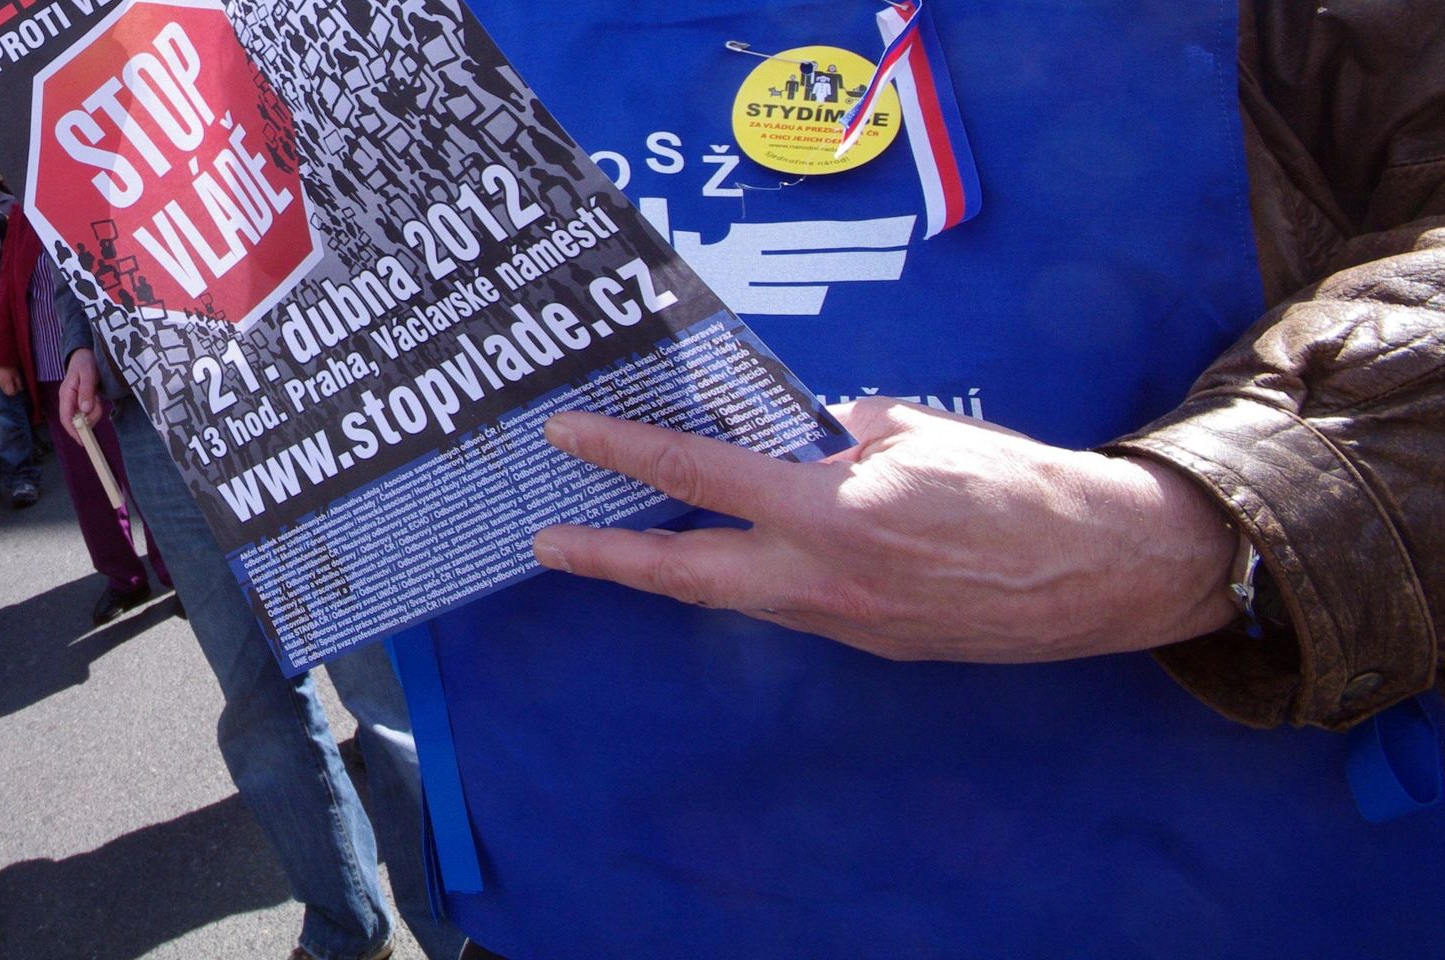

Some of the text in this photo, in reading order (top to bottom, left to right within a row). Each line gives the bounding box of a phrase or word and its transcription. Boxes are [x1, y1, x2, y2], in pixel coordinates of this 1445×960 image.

[55, 22, 215, 209] STOP
[132, 110, 294, 299] VLÁDĚ
[746, 103, 844, 124] STYDÍM
[188, 198, 620, 467] 13 hod. Praha, Václavské náměstí
[192, 164, 545, 414] 21. dubna 2012
[217, 259, 679, 524] www.stopvlade.cz
